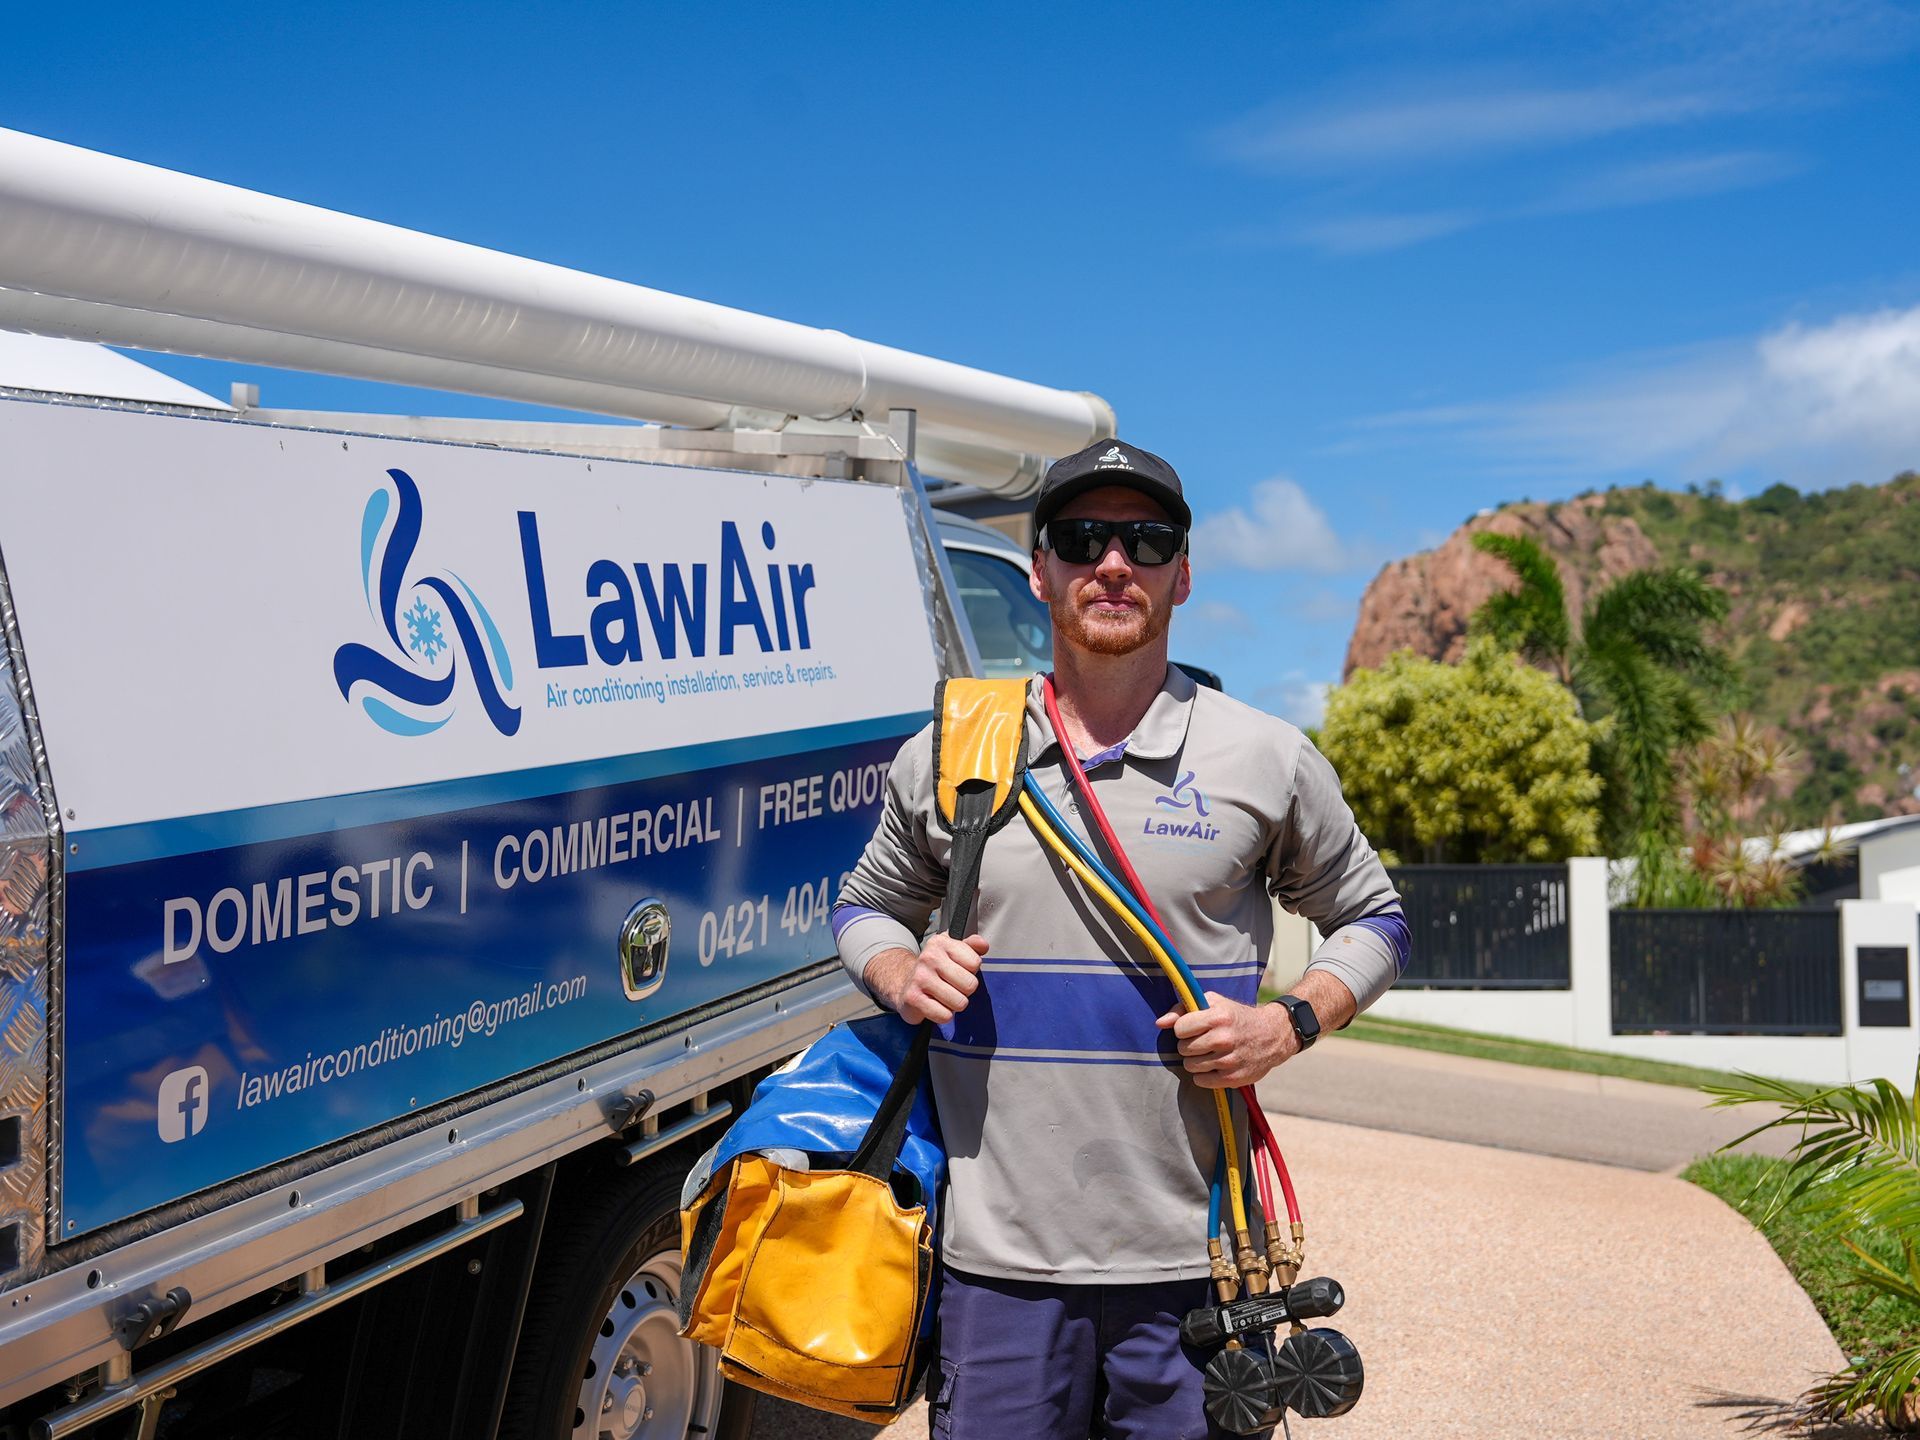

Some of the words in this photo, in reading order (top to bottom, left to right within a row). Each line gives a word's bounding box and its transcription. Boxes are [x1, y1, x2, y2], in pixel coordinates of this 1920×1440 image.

[517, 510, 816, 669] LawAir
[546, 682, 568, 709] Air
[573, 674, 666, 705] conditioning
[666, 669, 742, 693] installation,
[743, 665, 785, 689] service
[785, 662, 797, 684] &
[797, 660, 838, 688] repairs.
[163, 851, 435, 966] DOMESTIC
[494, 797, 722, 891] COMMERCIAL
[759, 775, 824, 830] FREE
[829, 761, 896, 813] QUOT
[1143, 817, 1221, 841] LawAir
[698, 895, 769, 967] 0421
[780, 876, 830, 938] 404
[236, 974, 588, 1110] lawairconditioning@gmail.com
